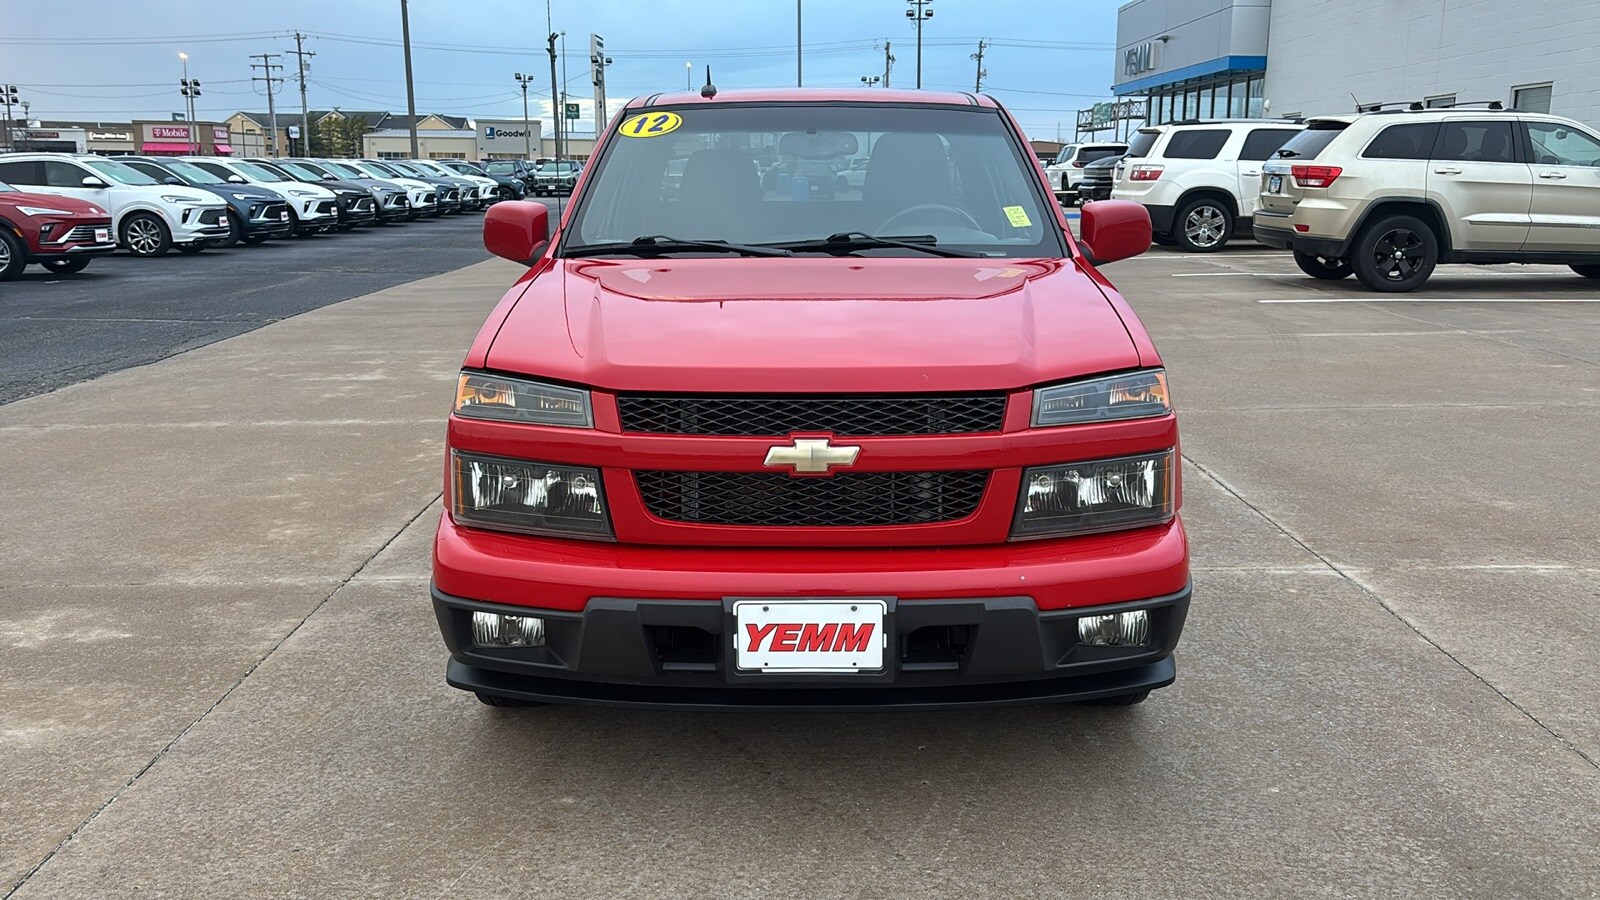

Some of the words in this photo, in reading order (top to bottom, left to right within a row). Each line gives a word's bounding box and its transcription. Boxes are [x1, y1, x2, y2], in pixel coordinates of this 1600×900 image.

[162, 128, 188, 138] Mobile
[633, 114, 669, 134] 12
[745, 623, 876, 653] YEMM
